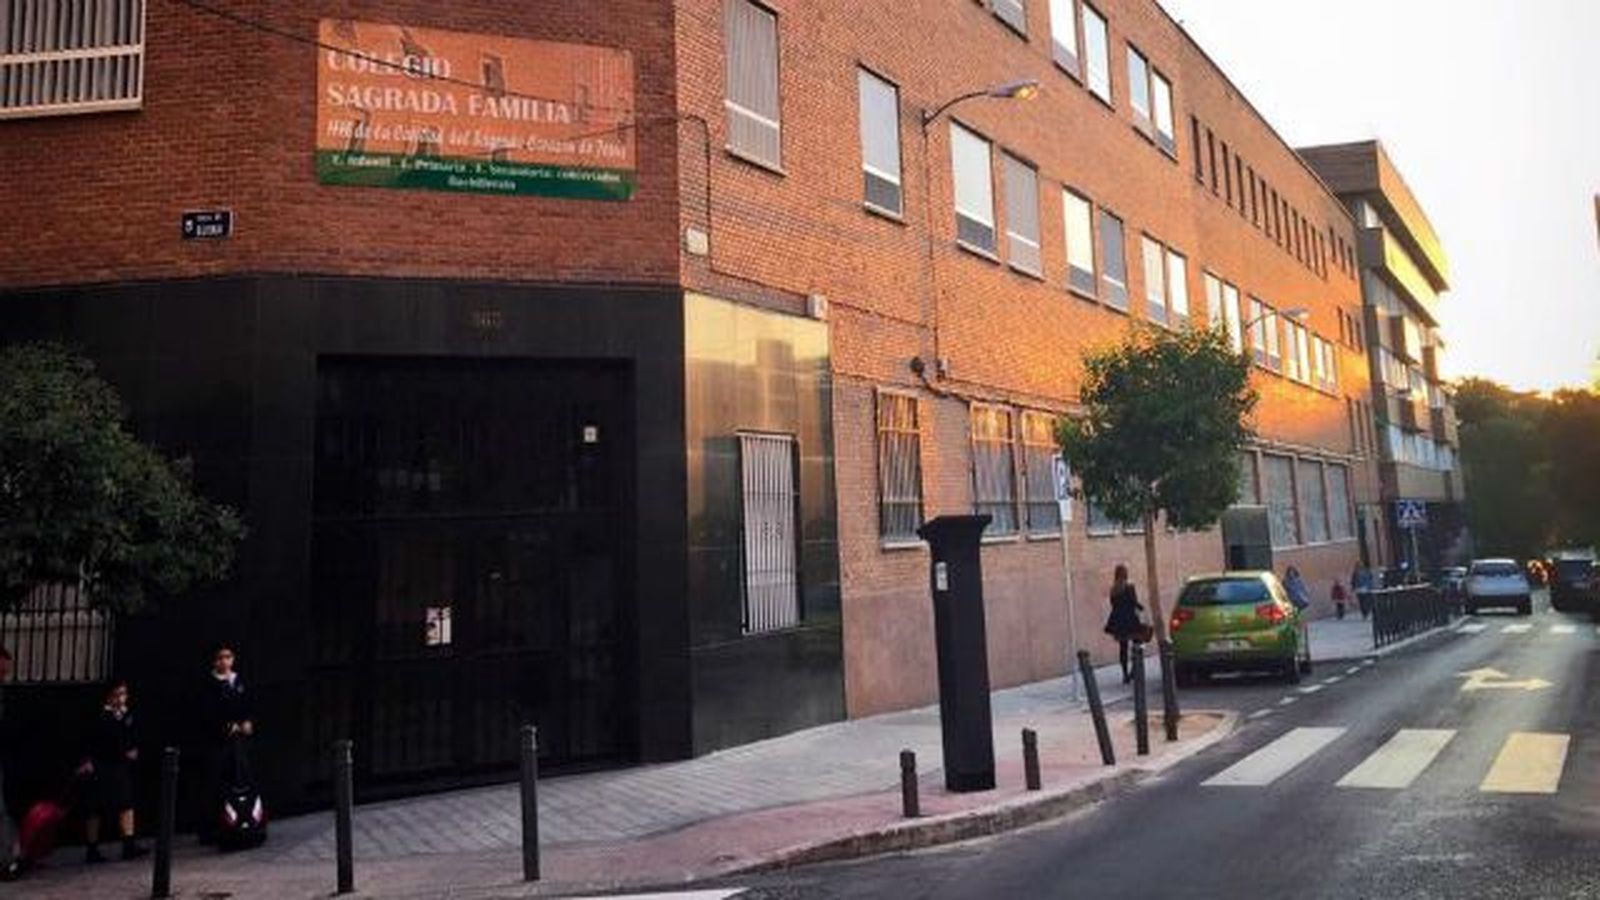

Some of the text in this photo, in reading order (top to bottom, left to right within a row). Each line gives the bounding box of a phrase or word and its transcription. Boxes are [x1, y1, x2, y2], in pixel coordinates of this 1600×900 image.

[327, 50, 451, 79] COLEGIO
[328, 82, 570, 123] SAGRADA FAMILIA
